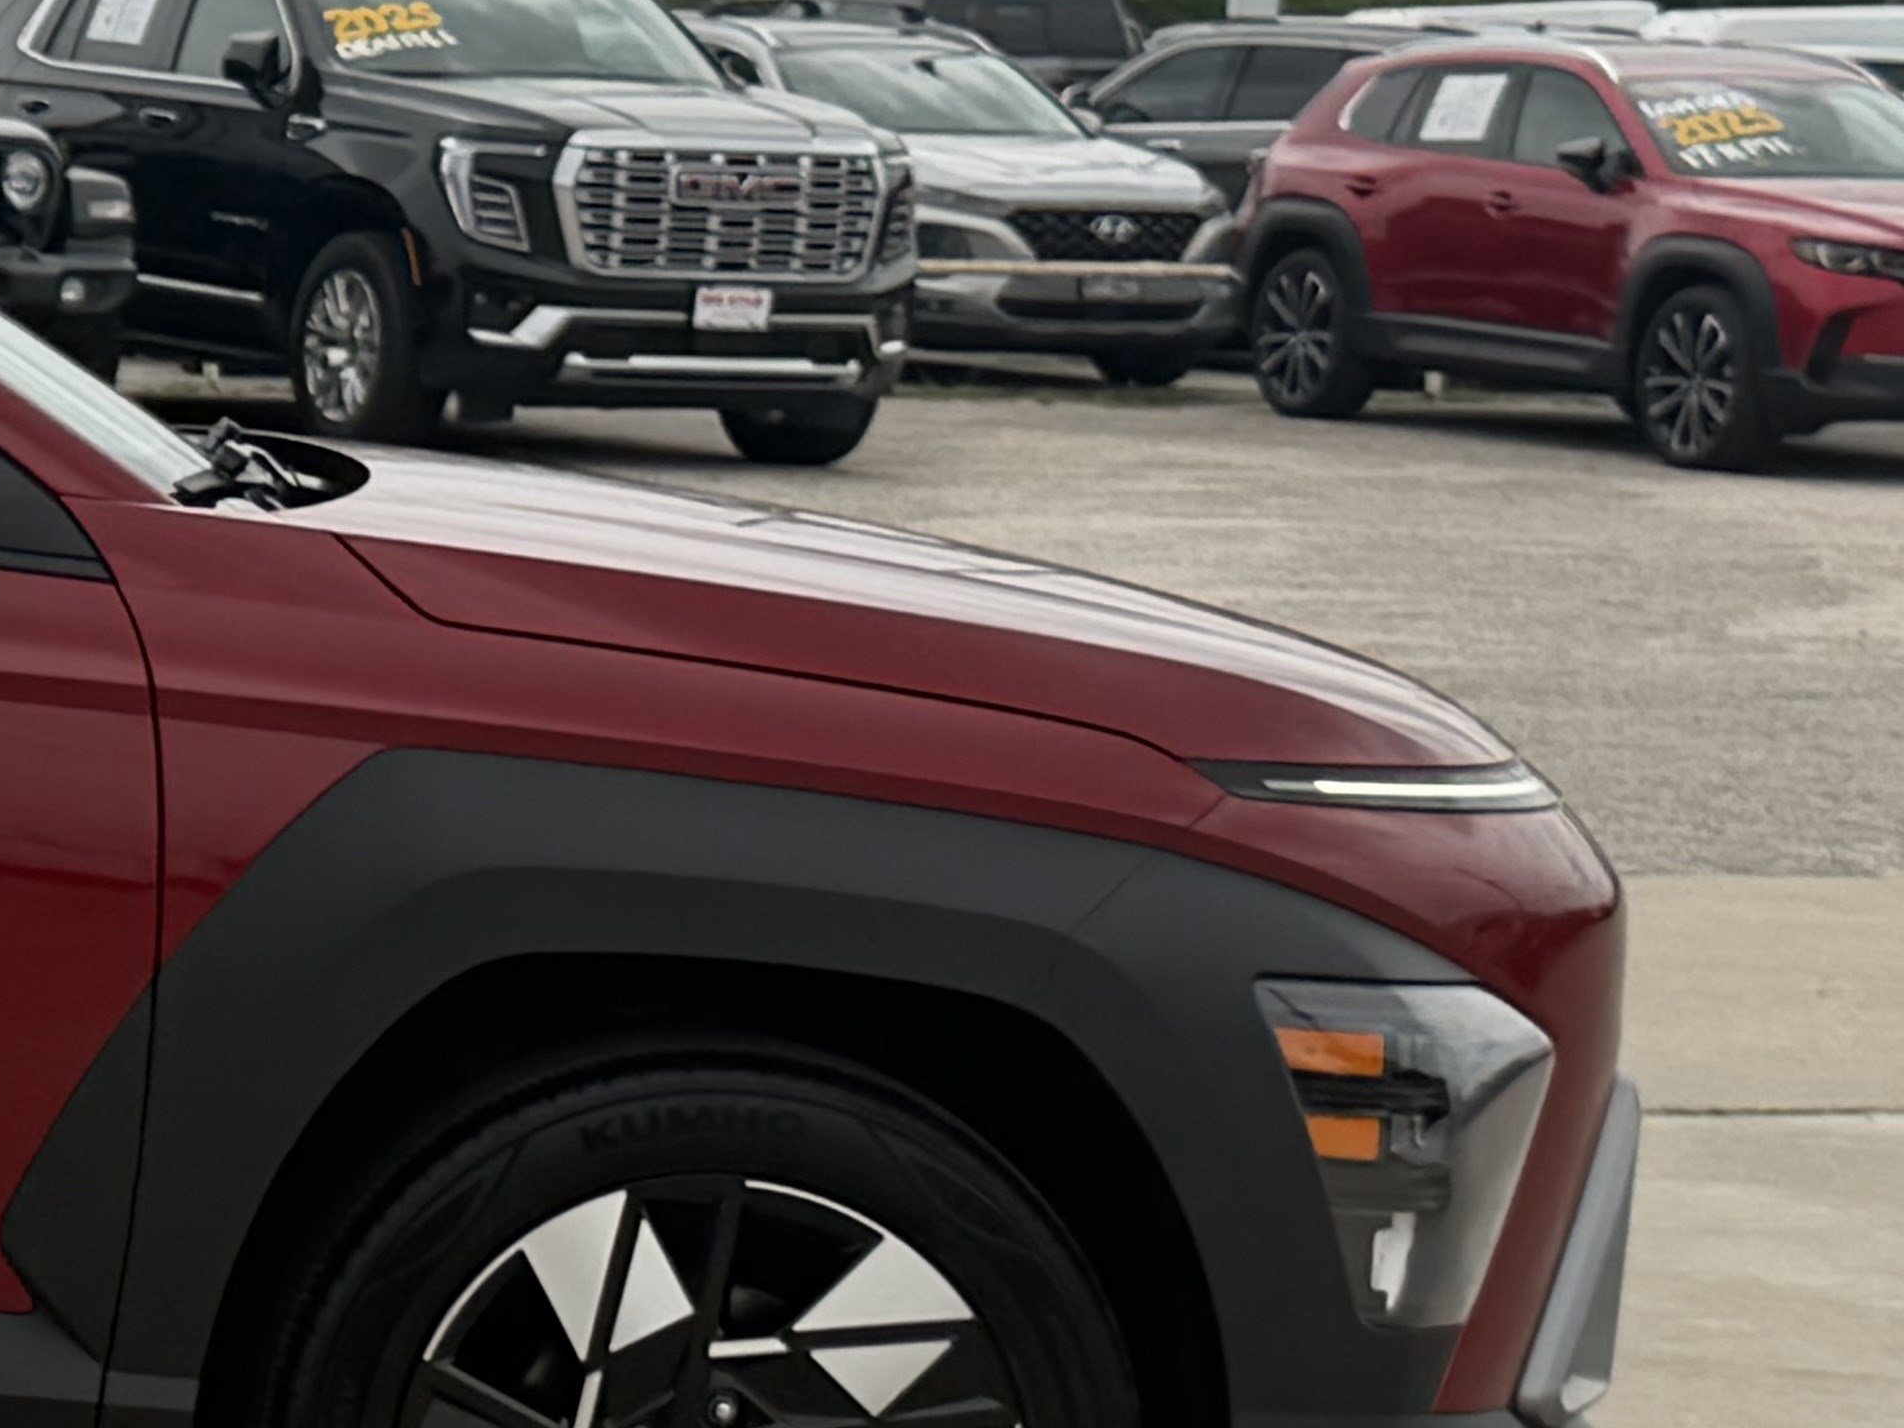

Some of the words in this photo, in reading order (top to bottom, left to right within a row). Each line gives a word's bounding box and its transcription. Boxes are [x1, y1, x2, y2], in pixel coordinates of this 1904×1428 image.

[322, 0, 443, 46] 2025
[1655, 106, 1786, 147] 2025
[678, 174, 803, 202] GMC
[579, 1105, 806, 1150] KUMHO
